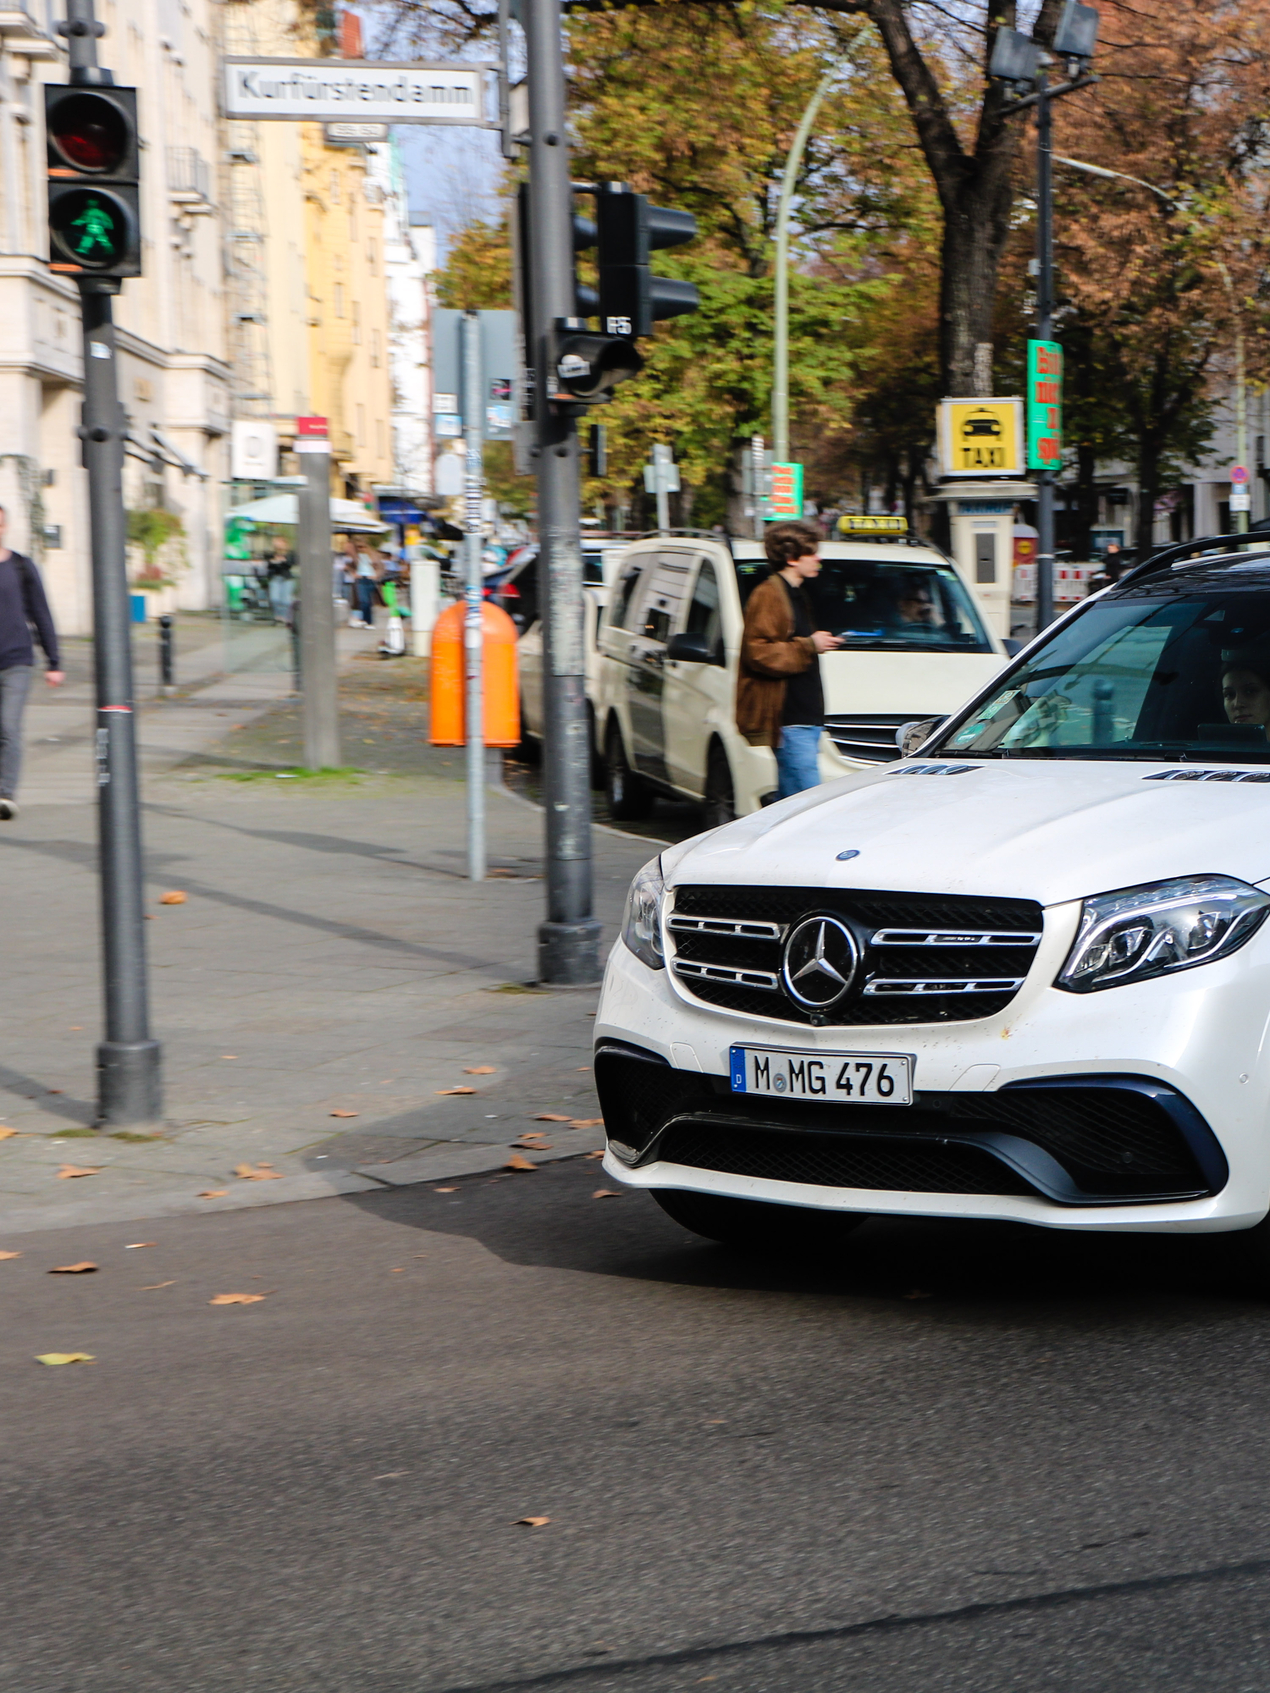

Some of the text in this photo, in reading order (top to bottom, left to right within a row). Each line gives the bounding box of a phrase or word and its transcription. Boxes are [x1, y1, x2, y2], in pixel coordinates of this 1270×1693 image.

[237, 70, 474, 105] Kurfürstendamm
[960, 447, 1005, 468] TAXI
[735, 1055, 895, 1097] D M MG 476
